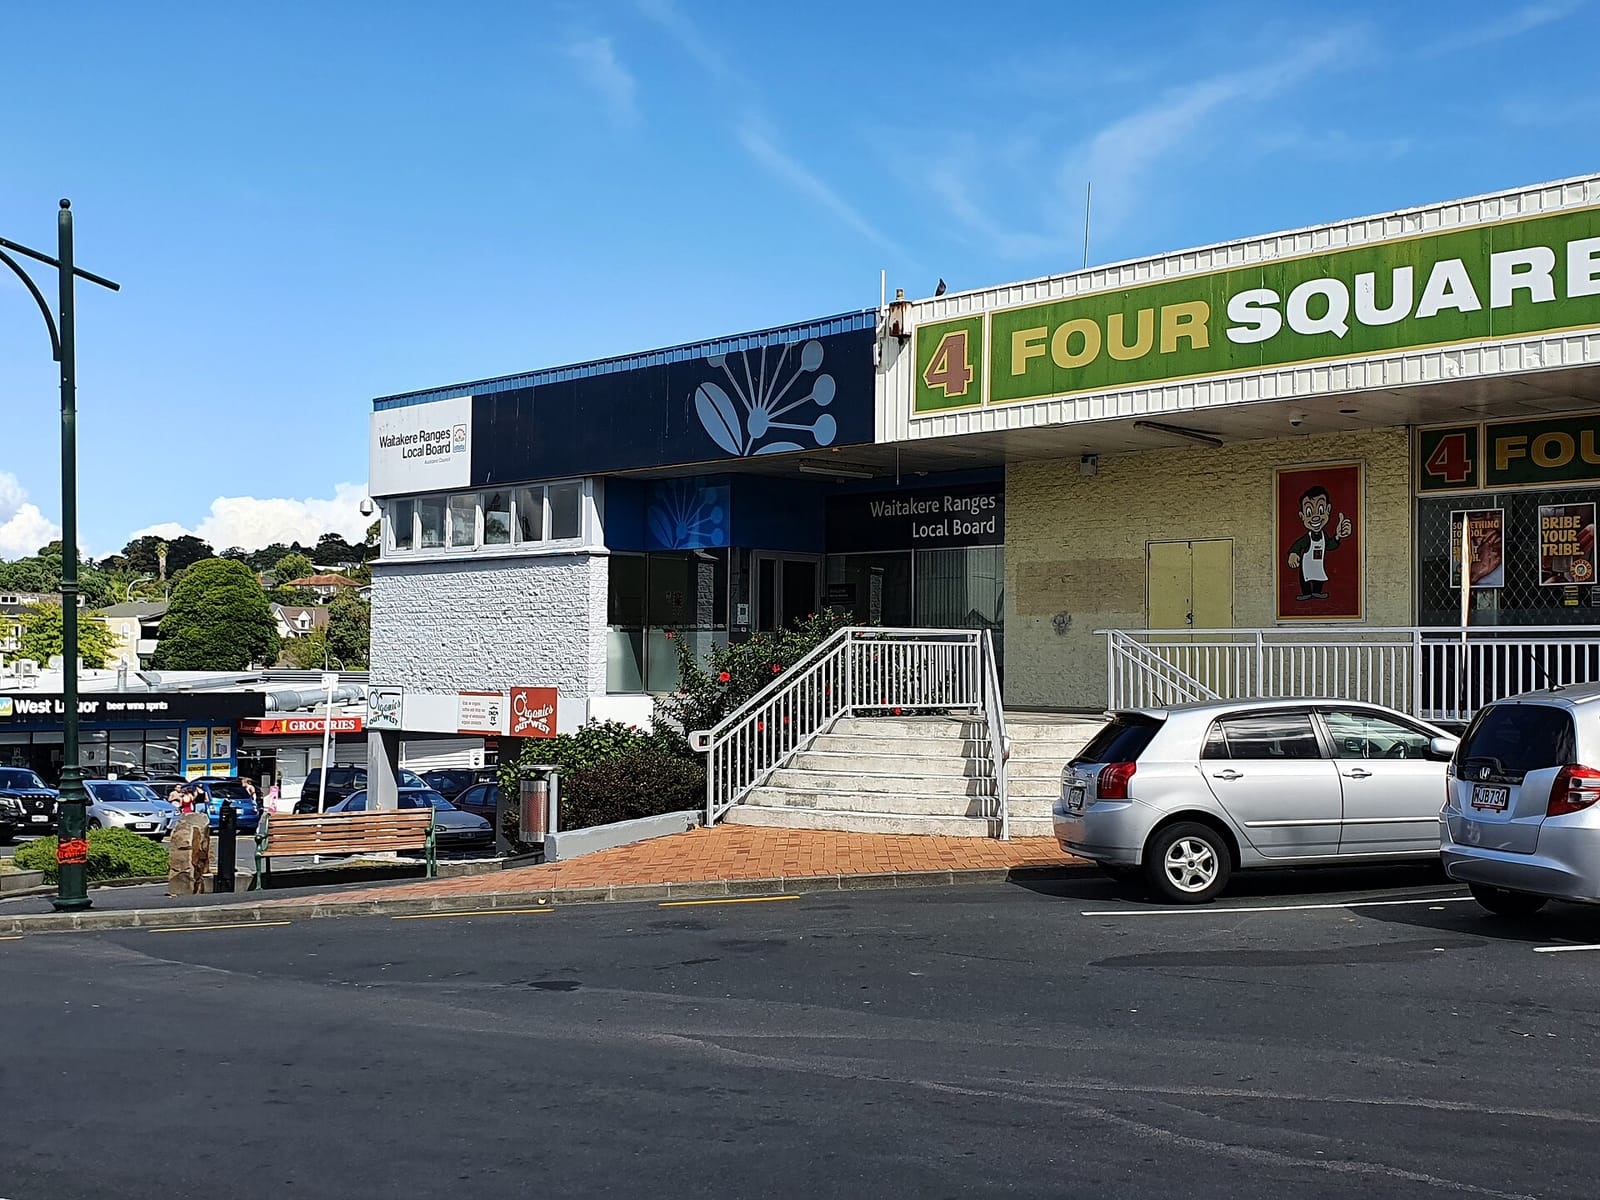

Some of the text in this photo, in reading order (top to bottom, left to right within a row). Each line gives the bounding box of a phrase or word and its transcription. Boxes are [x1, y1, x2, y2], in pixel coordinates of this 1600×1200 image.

[1011, 300, 1210, 376] FOUR
[924, 330, 974, 397] 4
[379, 429, 451, 449] Waitakere Ranges
[402, 441, 451, 459] Local Board
[1425, 433, 1472, 483] 4
[870, 495, 996, 518] Waitakere Ranges
[912, 515, 995, 538] Local Board
[1452, 520, 1500, 530] SOETHING
[1541, 516, 1581, 530] BRIBE
[1541, 529, 1577, 543] YOUR
[14, 699, 52, 714] West
[106, 701, 126, 711] beer
[514, 720, 551, 735] OUT WEST
